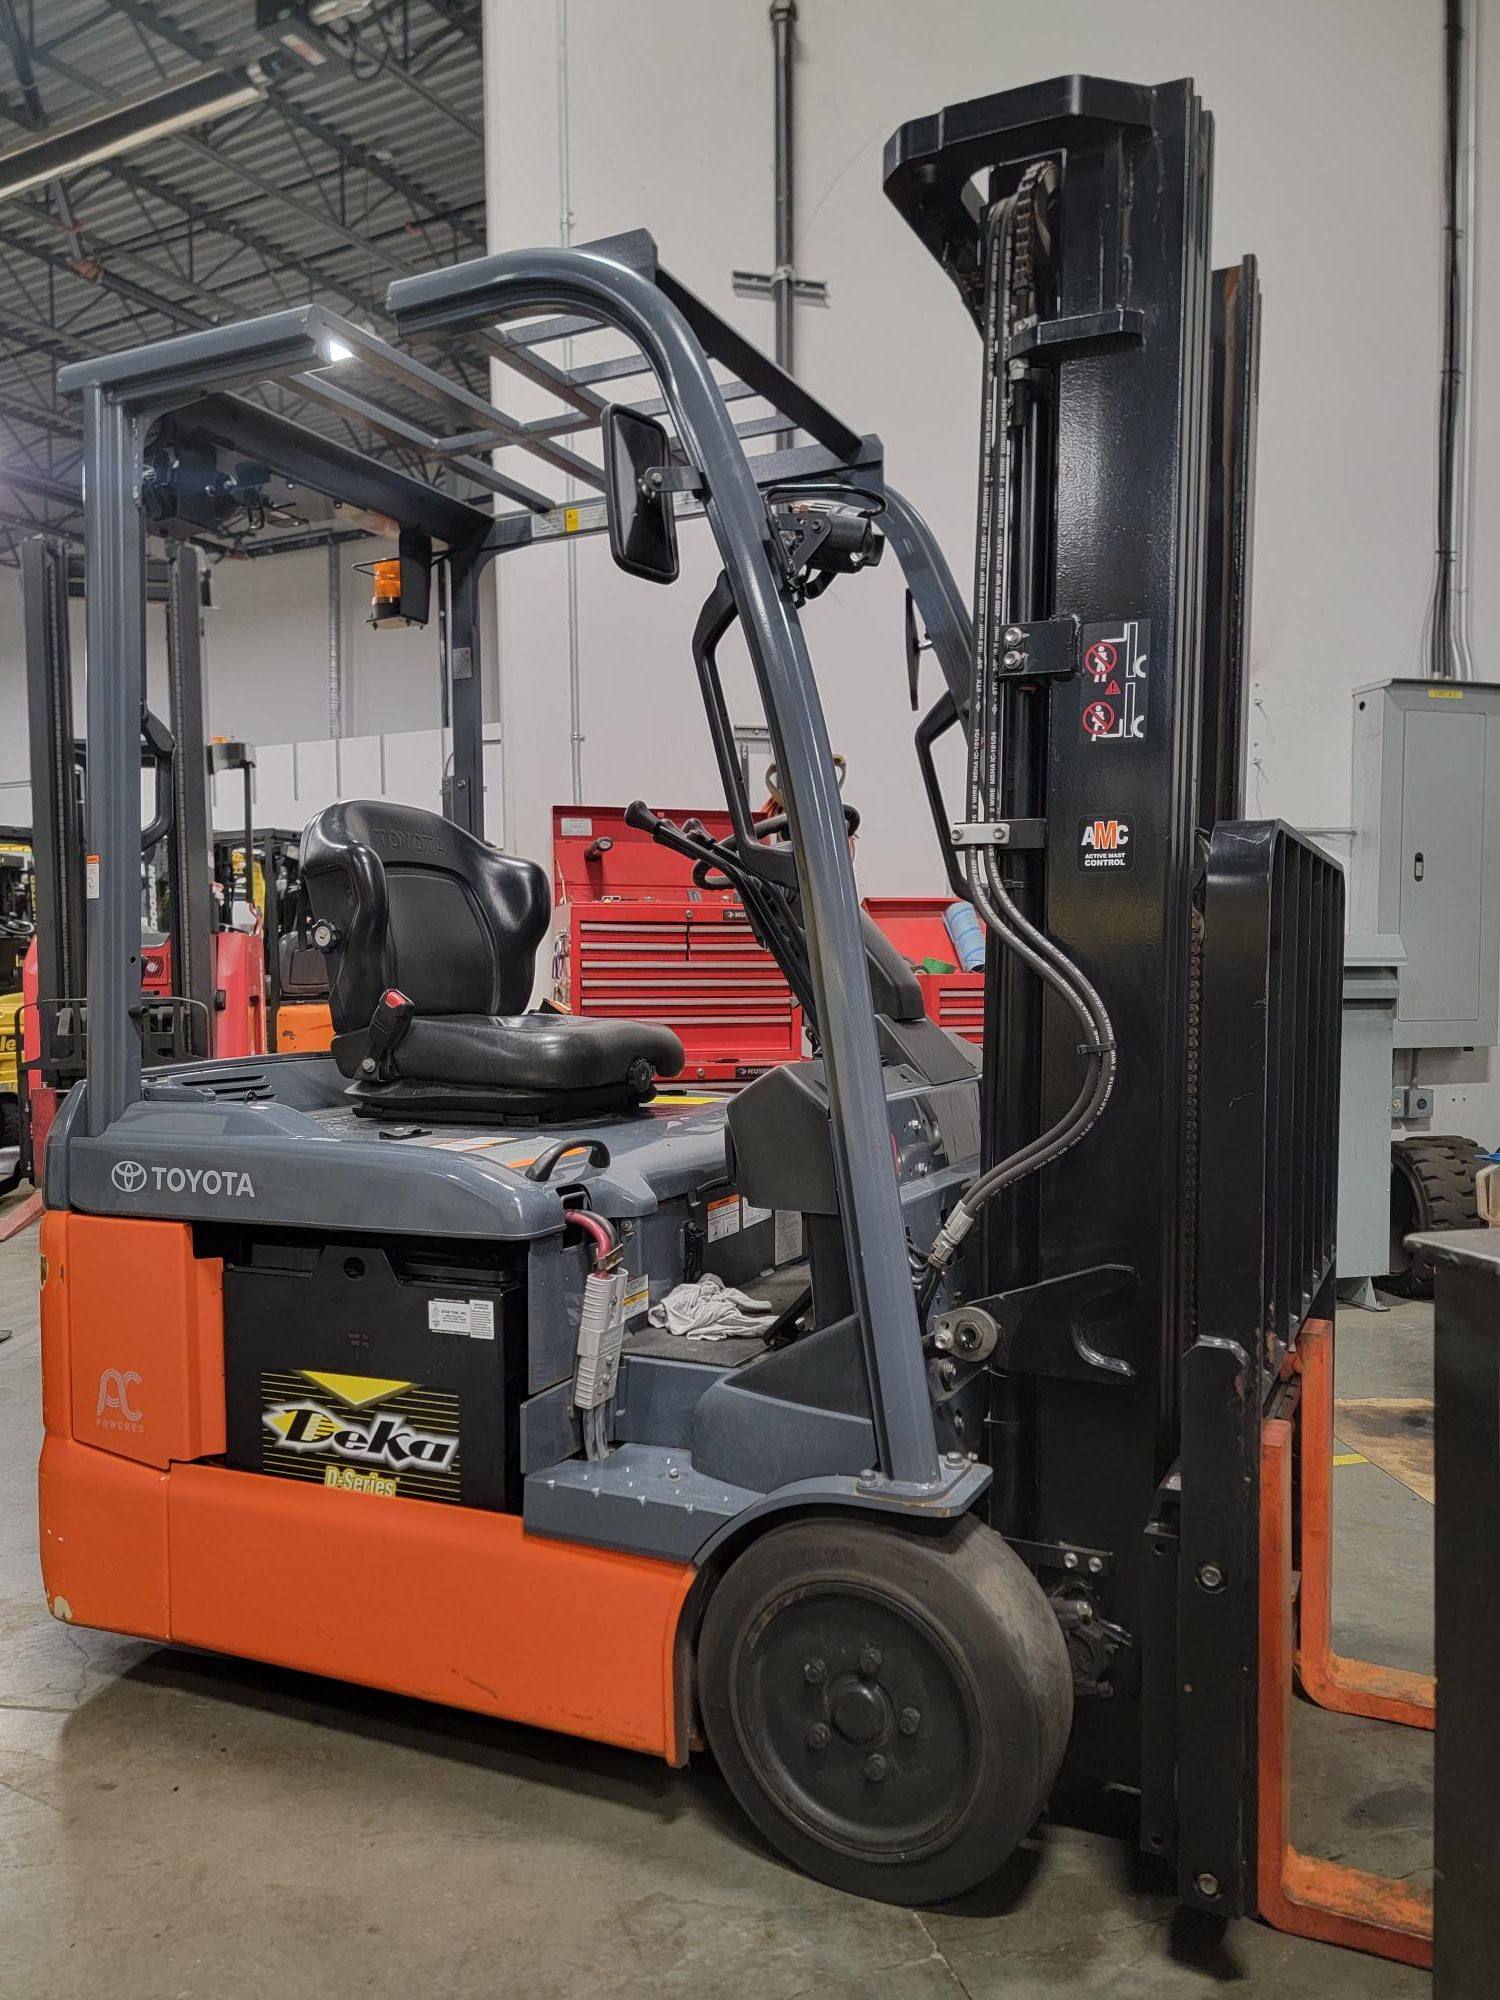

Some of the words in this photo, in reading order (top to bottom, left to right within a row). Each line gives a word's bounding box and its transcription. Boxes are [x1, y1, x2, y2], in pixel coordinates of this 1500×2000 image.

[980, 571, 986, 584] WP
[996, 573, 1002, 586] WP
[370, 828, 449, 856] TOYOTA
[1081, 820, 1129, 850] AMC
[1084, 859, 1126, 867] CONTROL
[148, 864, 158, 931] DOOSAN
[1081, 1005, 1096, 1027] MSHA
[1094, 1075, 1115, 1116] SAE100R16
[151, 1166, 256, 1198] TOYOTA
[96, 1368, 143, 1421] AC
[96, 1418, 145, 1434] POWERED
[276, 1406, 454, 1466] Deka
[325, 1465, 397, 1497] D-Series
